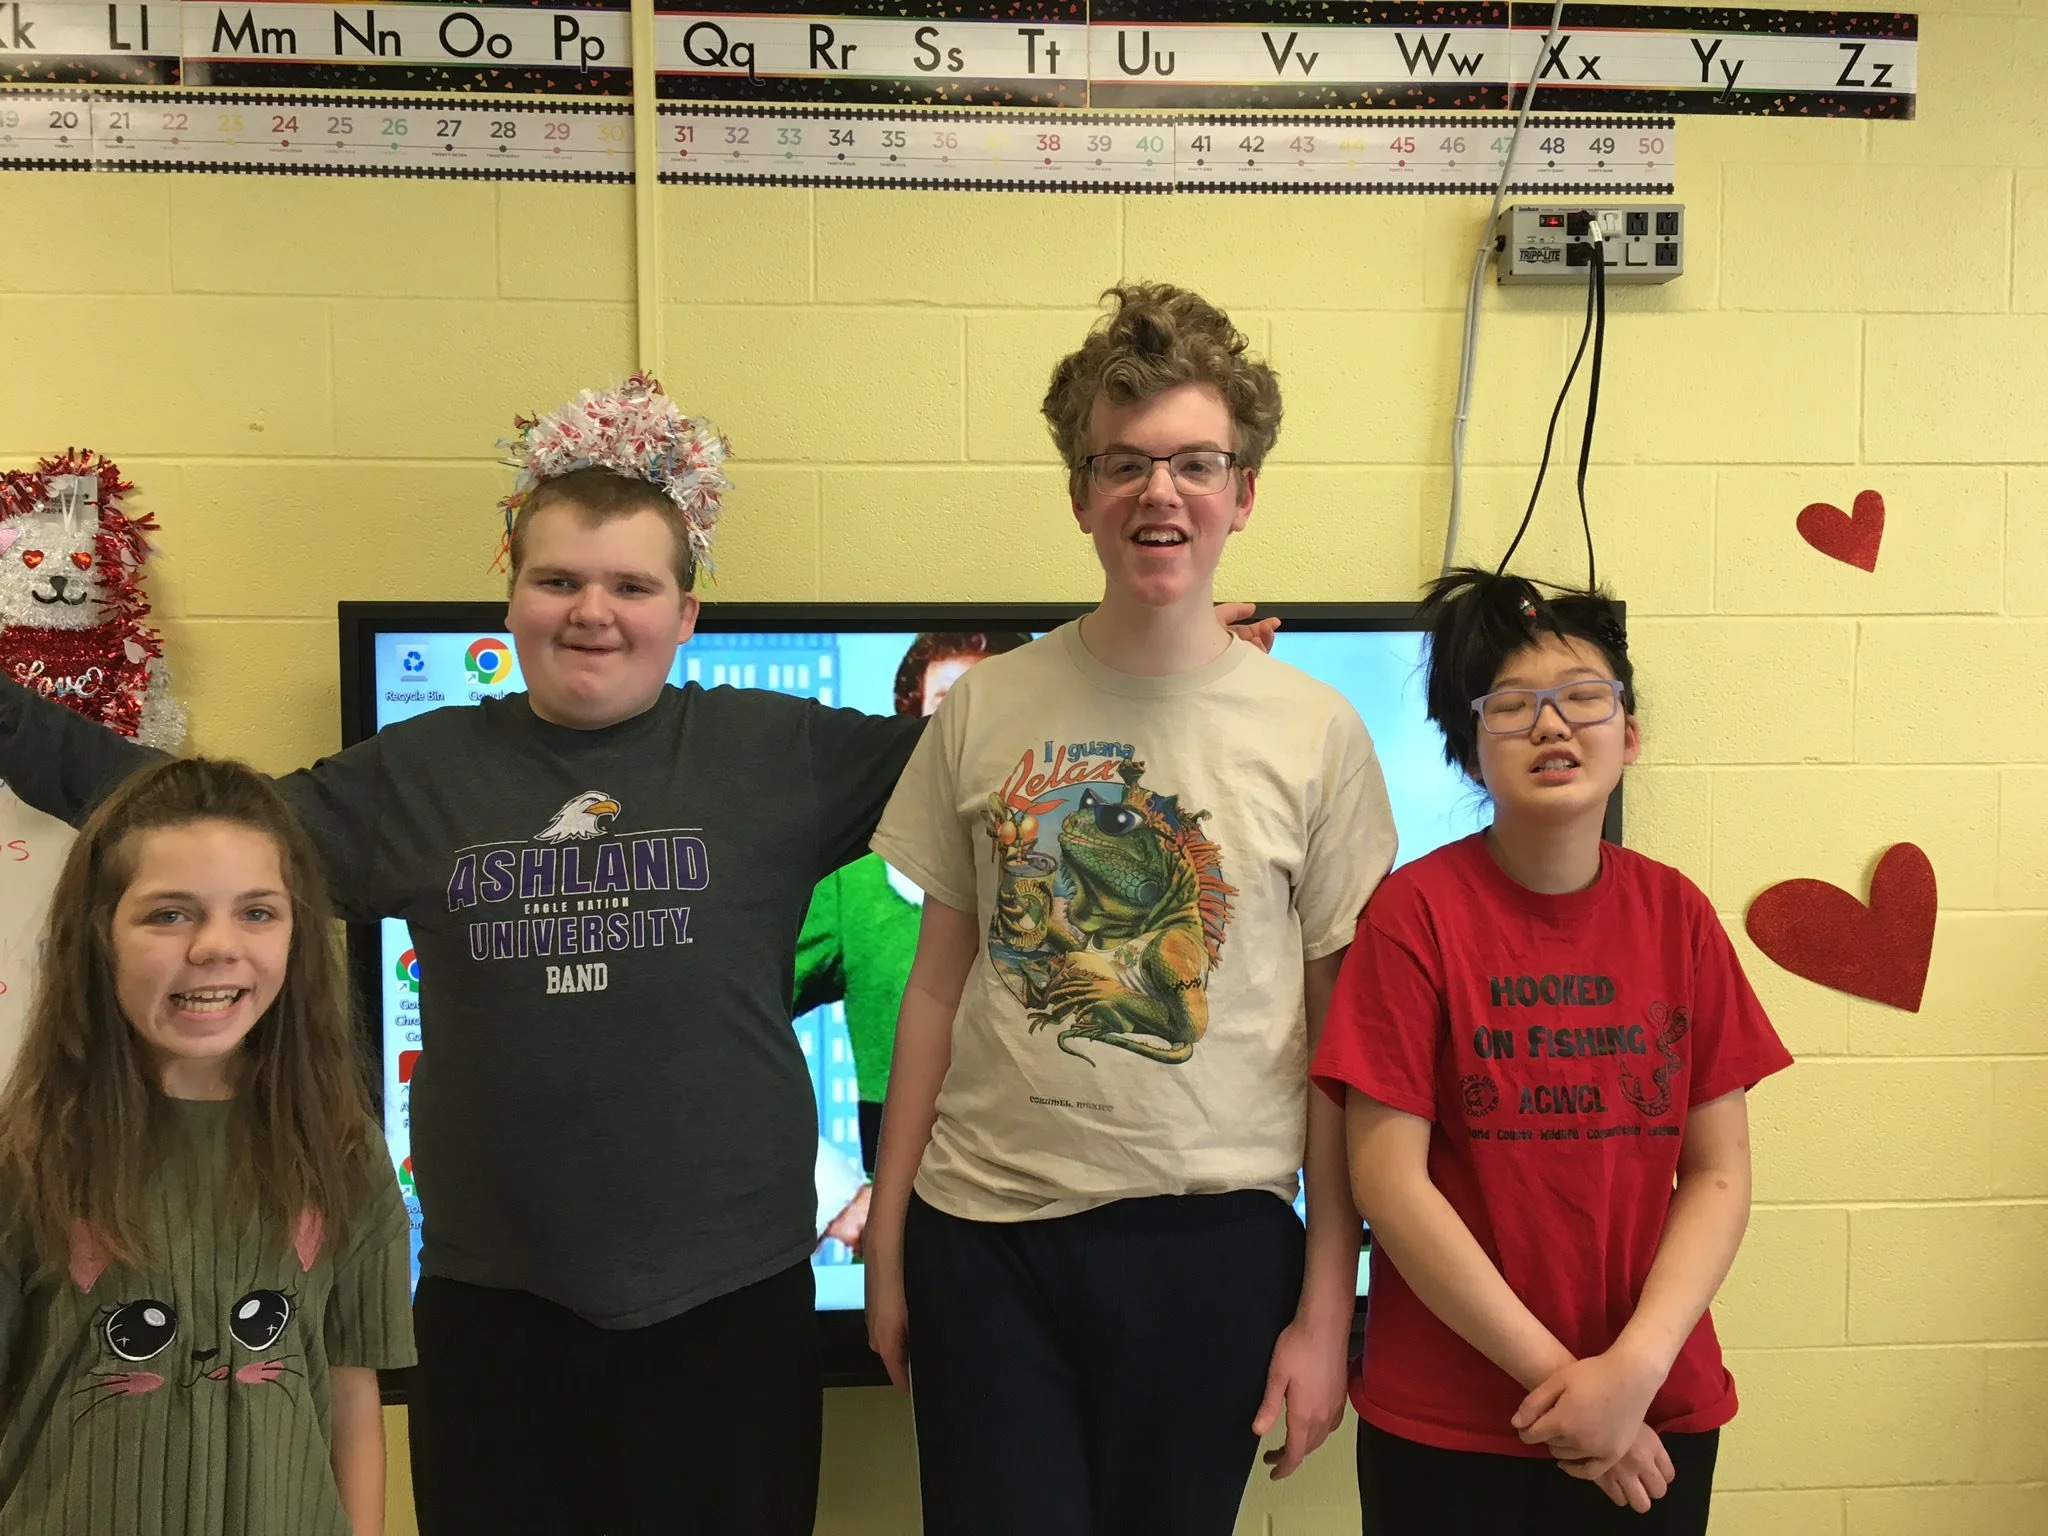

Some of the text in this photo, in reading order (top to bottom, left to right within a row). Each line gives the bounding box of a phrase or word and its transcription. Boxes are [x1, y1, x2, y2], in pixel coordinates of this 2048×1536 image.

[109, 3, 149, 51] Ll
[212, 8, 297, 54] Mm
[333, 9, 402, 57] Nn
[439, 12, 513, 59] Oo
[553, 14, 606, 73] Pp
[683, 21, 766, 87] Qq
[809, 23, 858, 70] Rr
[913, 26, 965, 73] Ss
[1017, 28, 1061, 75] Tt
[1117, 30, 1175, 76] Uu
[1261, 31, 1320, 76] Vv
[1394, 32, 1485, 77] Ww
[1538, 34, 1602, 80] Xx
[1690, 38, 1744, 104] Yy
[1835, 42, 1894, 88] Zz
[49, 111, 79, 129] 20
[109, 111, 131, 130] 21
[162, 112, 189, 131] 22
[217, 113, 244, 132] 23
[271, 115, 299, 133] 24
[327, 116, 353, 134] 25
[381, 117, 408, 136] 26
[436, 119, 462, 137] 27
[490, 121, 517, 139] 28
[544, 122, 571, 141] 29
[597, 124, 625, 142] 30
[674, 125, 694, 143] 31
[724, 126, 750, 144] 32
[777, 127, 802, 146] 33
[828, 129, 855, 147] 34
[881, 130, 906, 148] 35
[932, 131, 958, 149] 36
[1036, 134, 1061, 151] 38
[1086, 135, 1112, 152] 39
[1136, 135, 1164, 153] 40
[1190, 135, 1211, 153] 41
[1239, 135, 1265, 153] 42
[1289, 136, 1315, 153] 43
[1389, 136, 1416, 153] 45
[1439, 136, 1466, 154] 46
[1490, 136, 1515, 154] 47
[1539, 136, 1566, 154] 48
[1589, 137, 1616, 155] 49
[1638, 137, 1665, 155] 50
[385, 690, 445, 704] Recycle Bin
[1067, 740, 1136, 763] guana
[1000, 744, 1122, 816] Relax
[446, 836, 710, 913] ASHLAND
[524, 896, 630, 915] EAGLE NATION
[469, 906, 692, 961] UNIVERSITY
[545, 962, 608, 995] BAND
[1490, 973, 1617, 1007] HOOKED
[1473, 1024, 1647, 1060] ON FISHING
[1518, 1084, 1609, 1115] ACWCL
